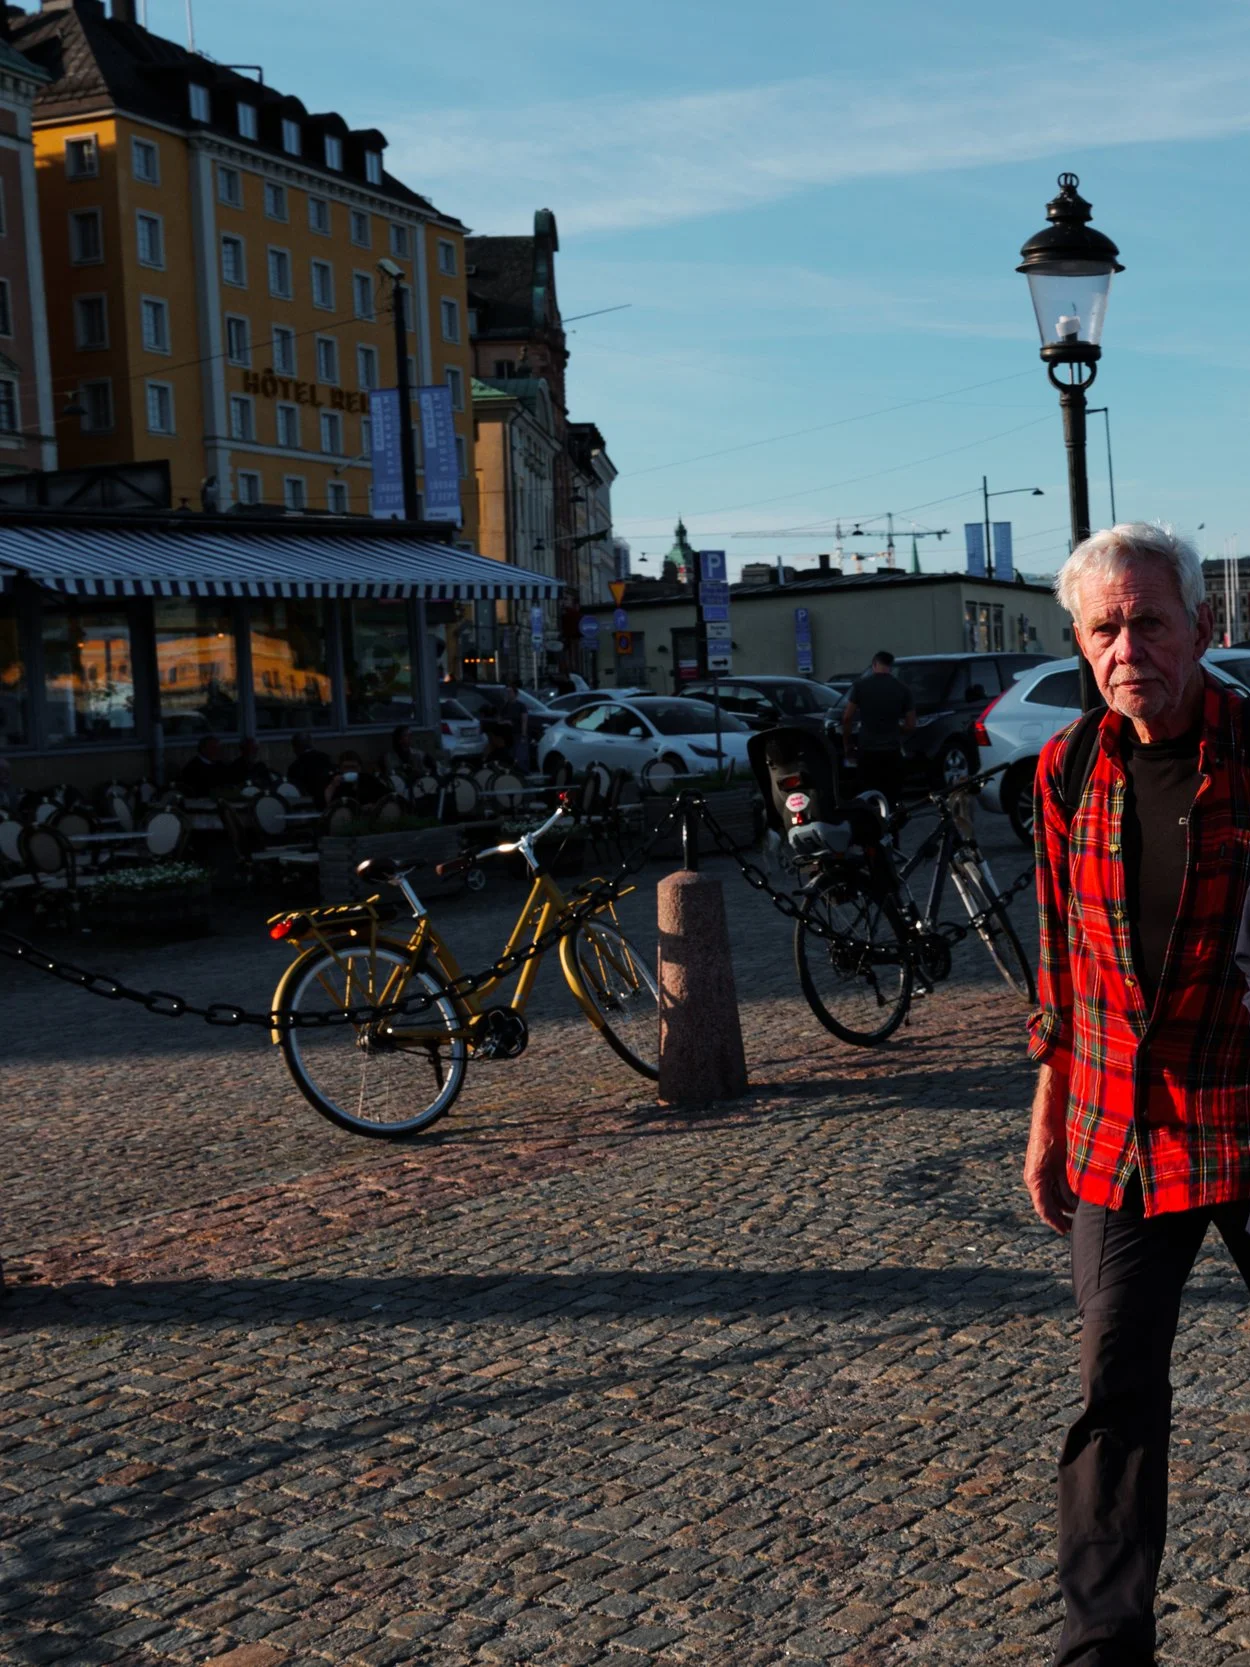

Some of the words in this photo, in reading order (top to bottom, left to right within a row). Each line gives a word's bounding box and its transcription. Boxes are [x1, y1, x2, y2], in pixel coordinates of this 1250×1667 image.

[242, 368, 324, 407] HÔTEL
[330, 388, 370, 413] REI
[383, 395, 395, 475] STOCKHOLM
[433, 392, 449, 473] STOCKHOLM
[707, 553, 721, 577] P
[798, 609, 806, 622] P
